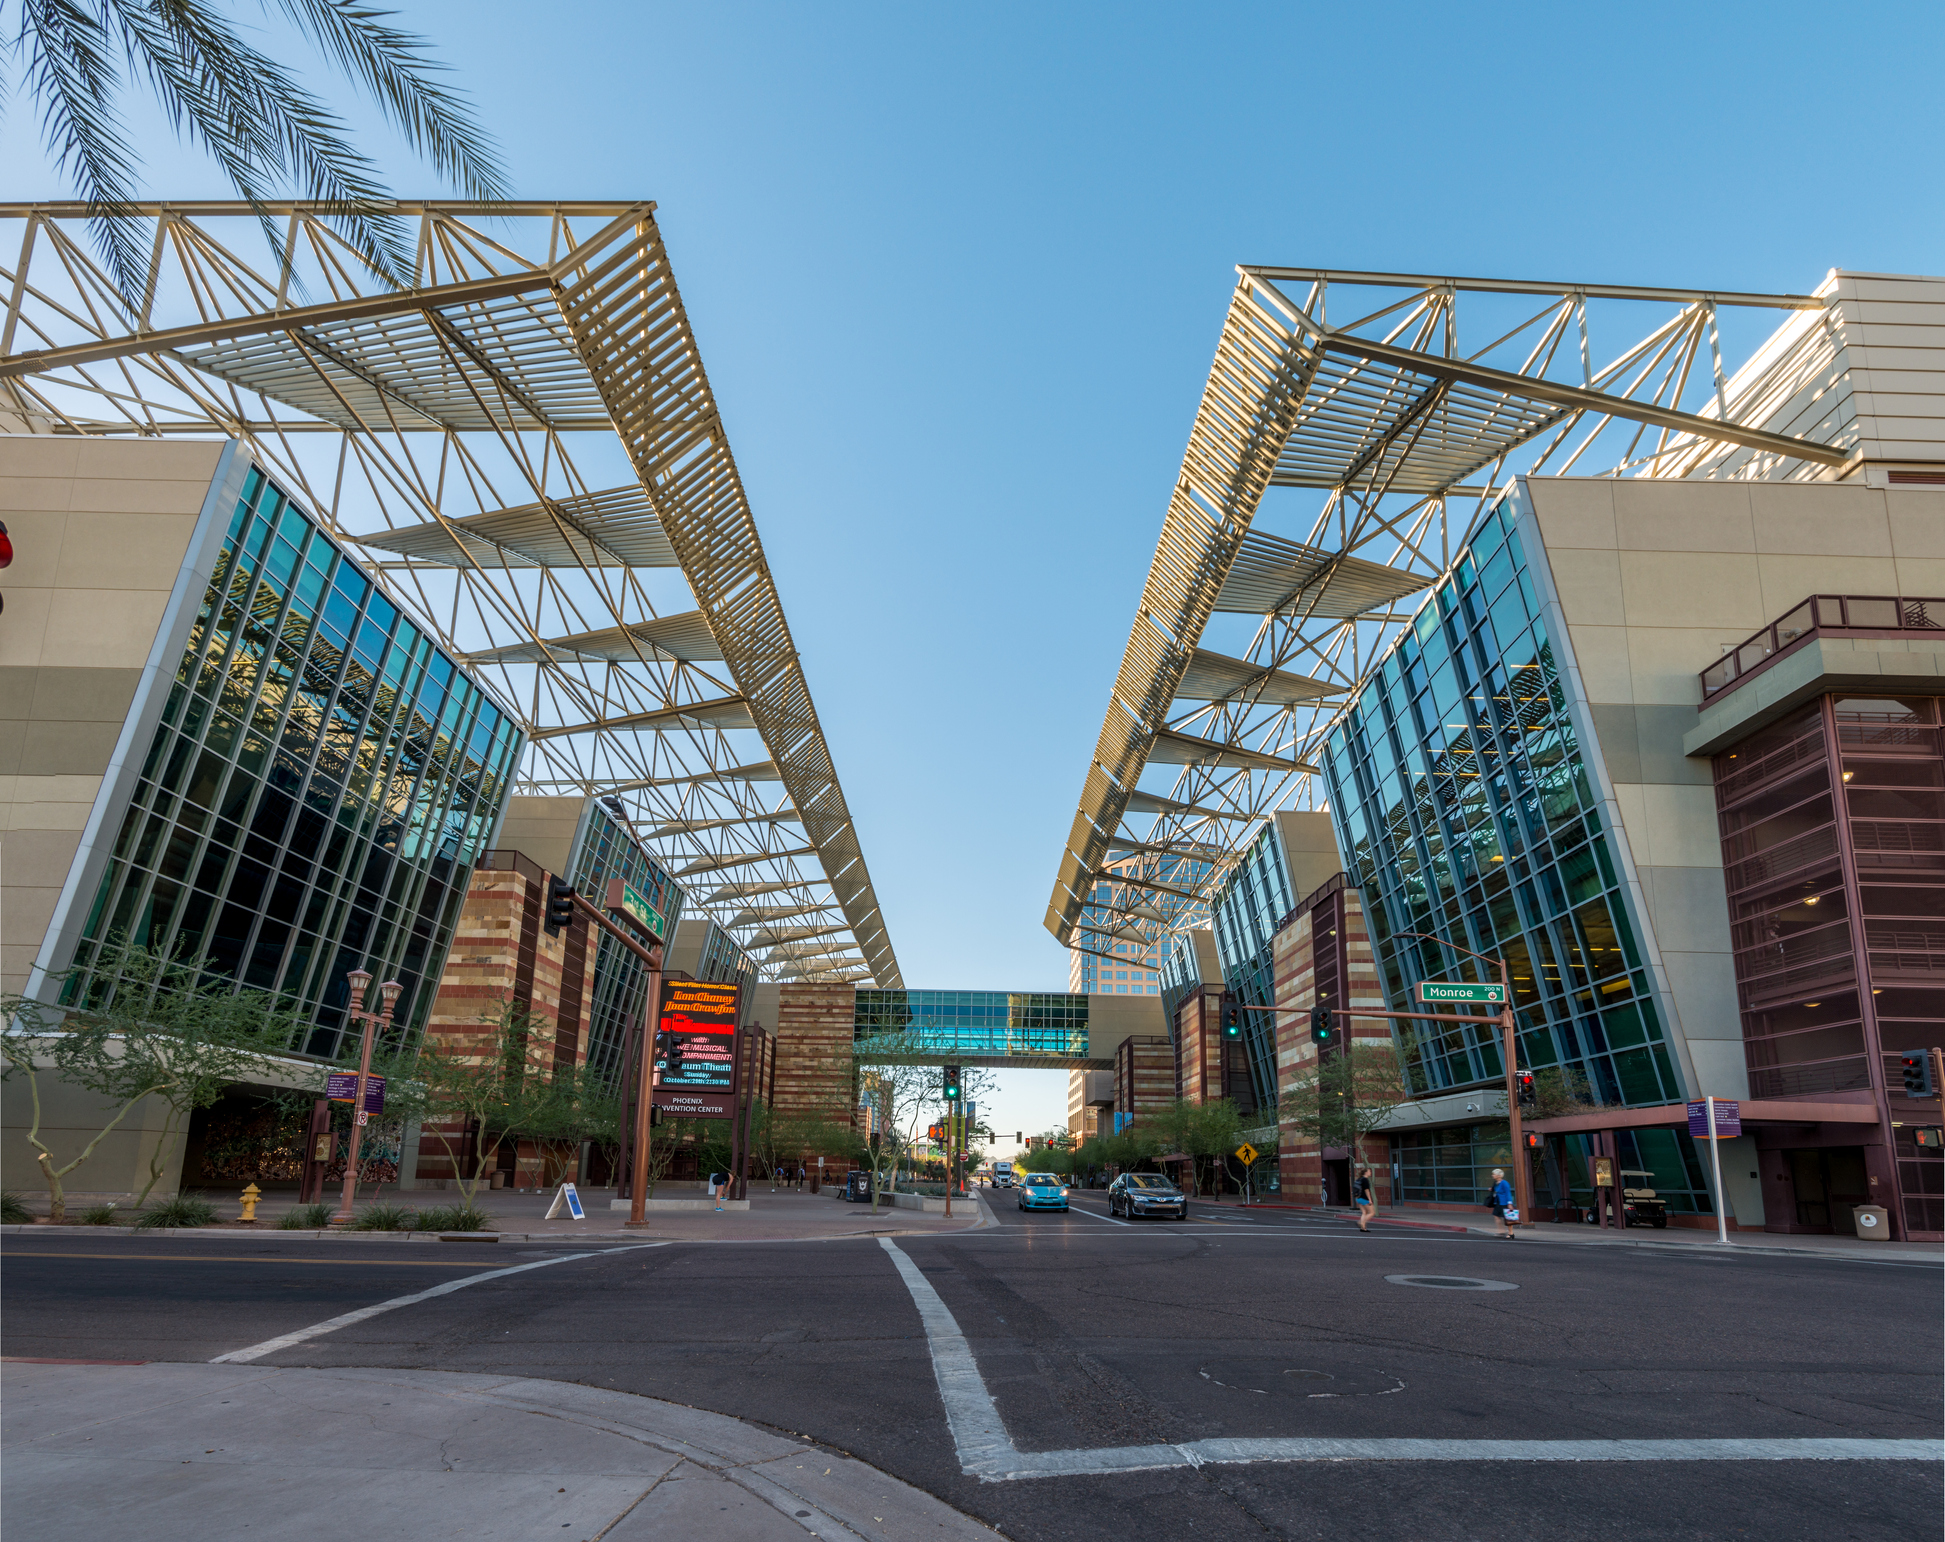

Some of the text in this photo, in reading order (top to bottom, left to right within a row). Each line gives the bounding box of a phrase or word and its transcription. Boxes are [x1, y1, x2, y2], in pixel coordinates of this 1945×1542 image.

[1430, 987, 1474, 998] Monroe
[673, 991, 736, 1005] Lon Chaney
[663, 1001, 691, 1012] Joan
[691, 1044, 728, 1053] MUSICAL
[672, 1097, 703, 1105] PHOENIX
[652, 1104, 697, 1112] NVENTION
